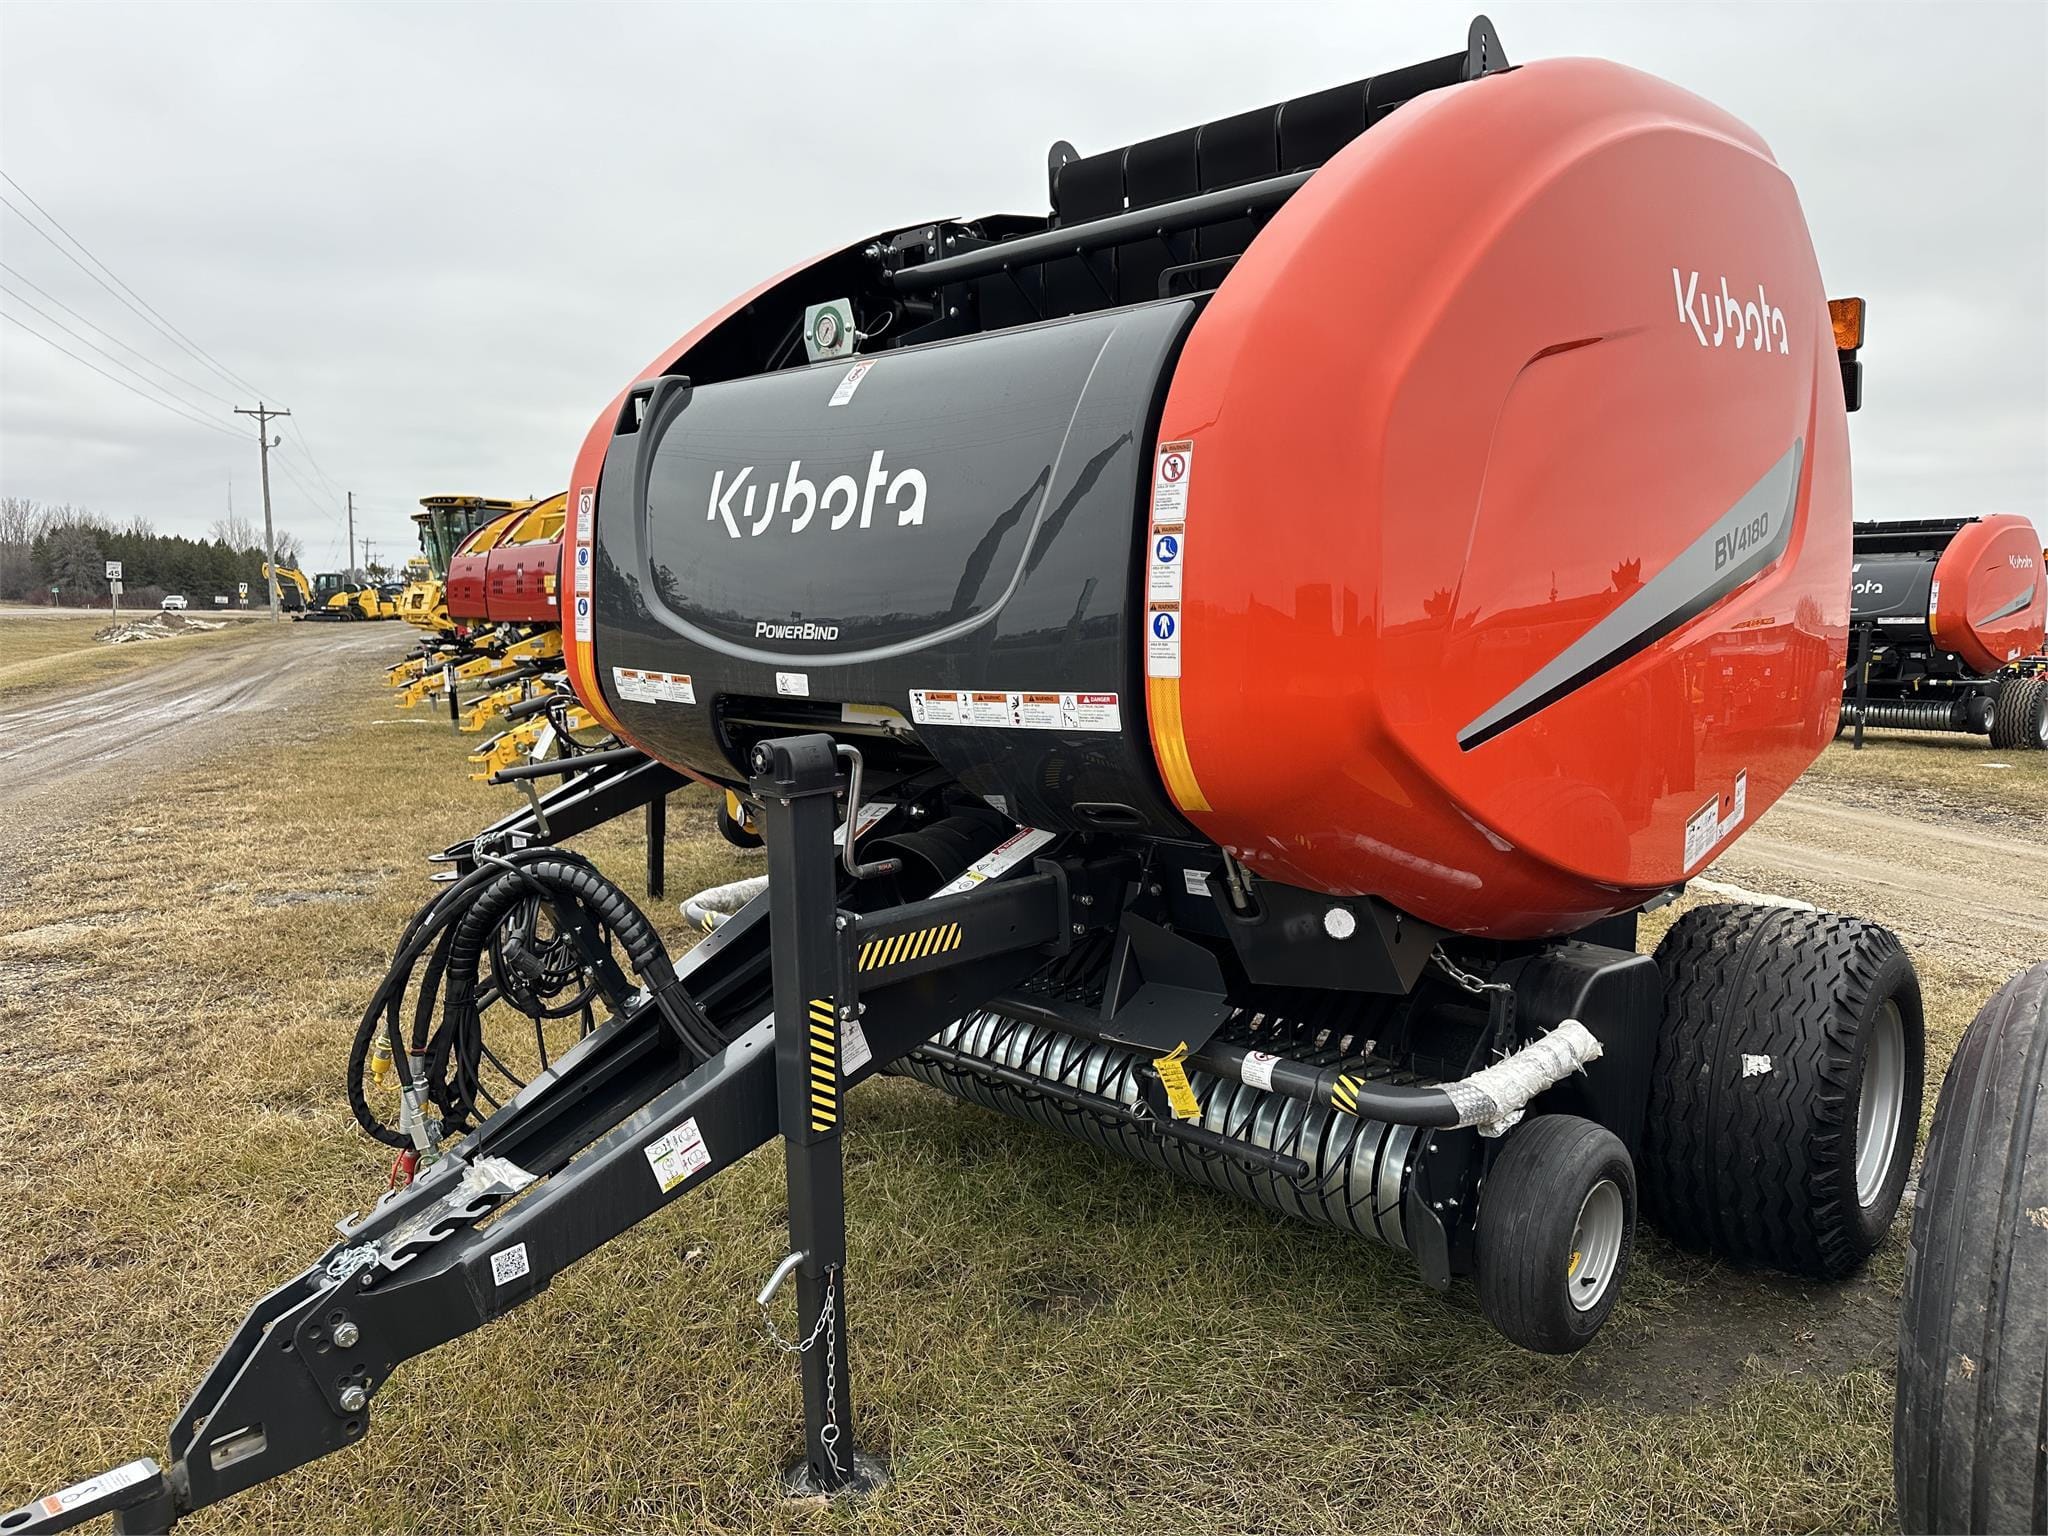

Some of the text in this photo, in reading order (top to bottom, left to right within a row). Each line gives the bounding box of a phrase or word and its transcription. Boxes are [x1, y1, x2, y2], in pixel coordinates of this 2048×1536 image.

[1672, 267, 1790, 355] Kubota
[706, 449, 928, 539] Kubota
[1714, 511, 1769, 572] BV4180
[2008, 554, 2033, 569] Kubota
